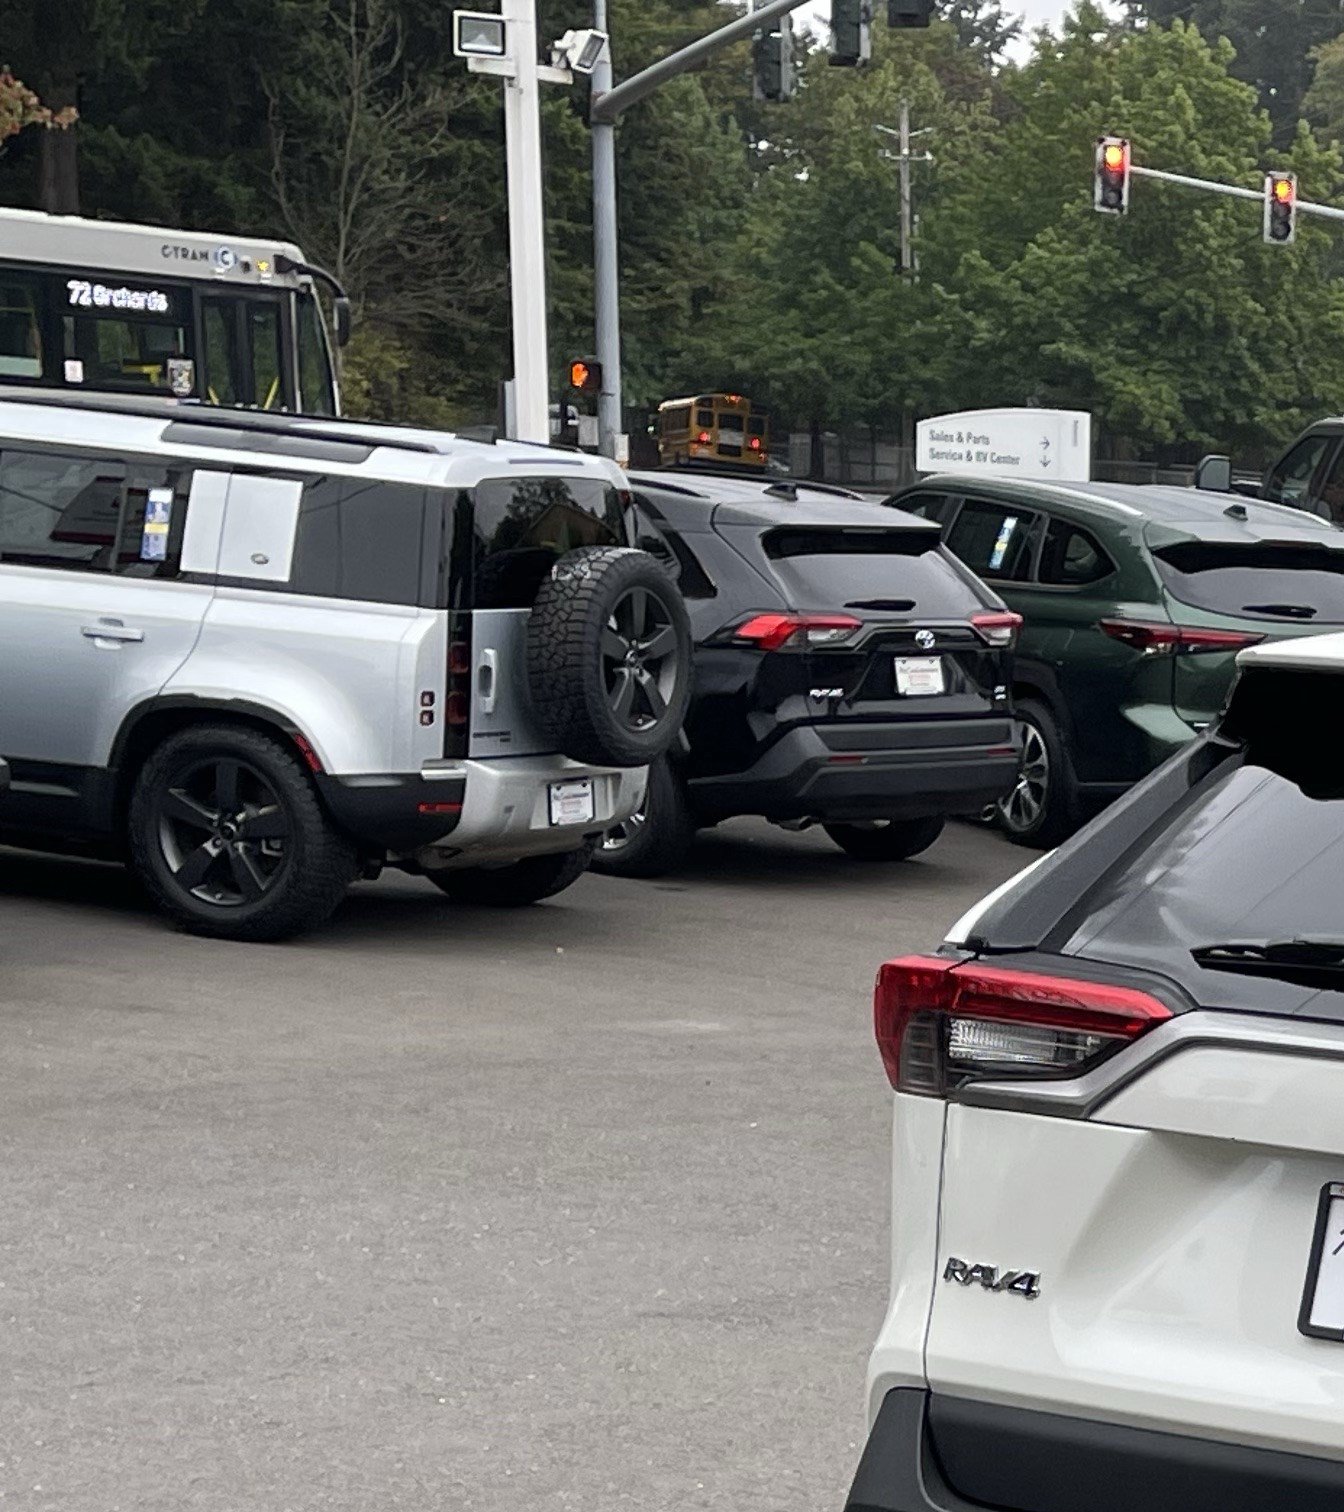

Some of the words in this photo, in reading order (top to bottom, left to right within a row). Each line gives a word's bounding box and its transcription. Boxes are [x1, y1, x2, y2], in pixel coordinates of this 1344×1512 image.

[66, 279, 92, 307] 72
[92, 284, 169, 313] Orchards
[929, 428, 954, 442] Sales
[956, 431, 965, 444] &
[966, 431, 991, 446] Parts
[929, 447, 963, 462] Service
[966, 449, 973, 462] &
[990, 451, 1021, 465] Center
[943, 1255, 1041, 1301] RAV4
